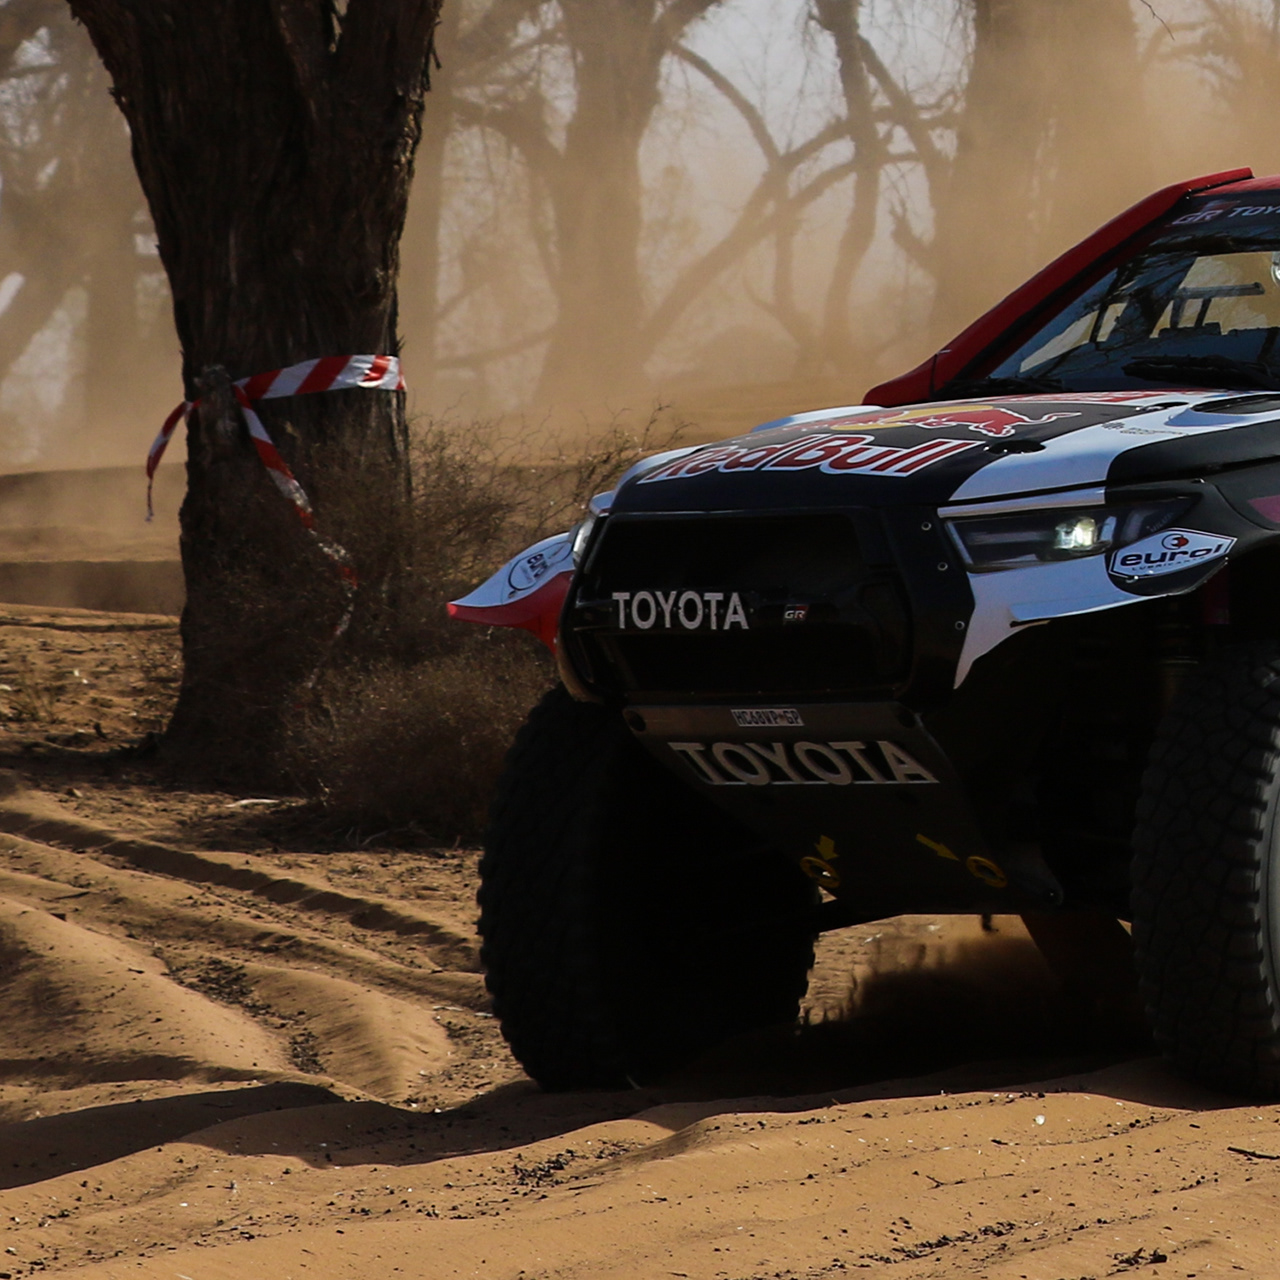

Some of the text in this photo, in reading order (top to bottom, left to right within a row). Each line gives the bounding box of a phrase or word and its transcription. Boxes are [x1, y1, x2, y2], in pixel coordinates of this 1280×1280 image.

[1120, 543, 1225, 567] eurol
[612, 591, 750, 630] TOYOTA
[784, 609, 806, 620] GR
[667, 740, 940, 786] TOYOTA
